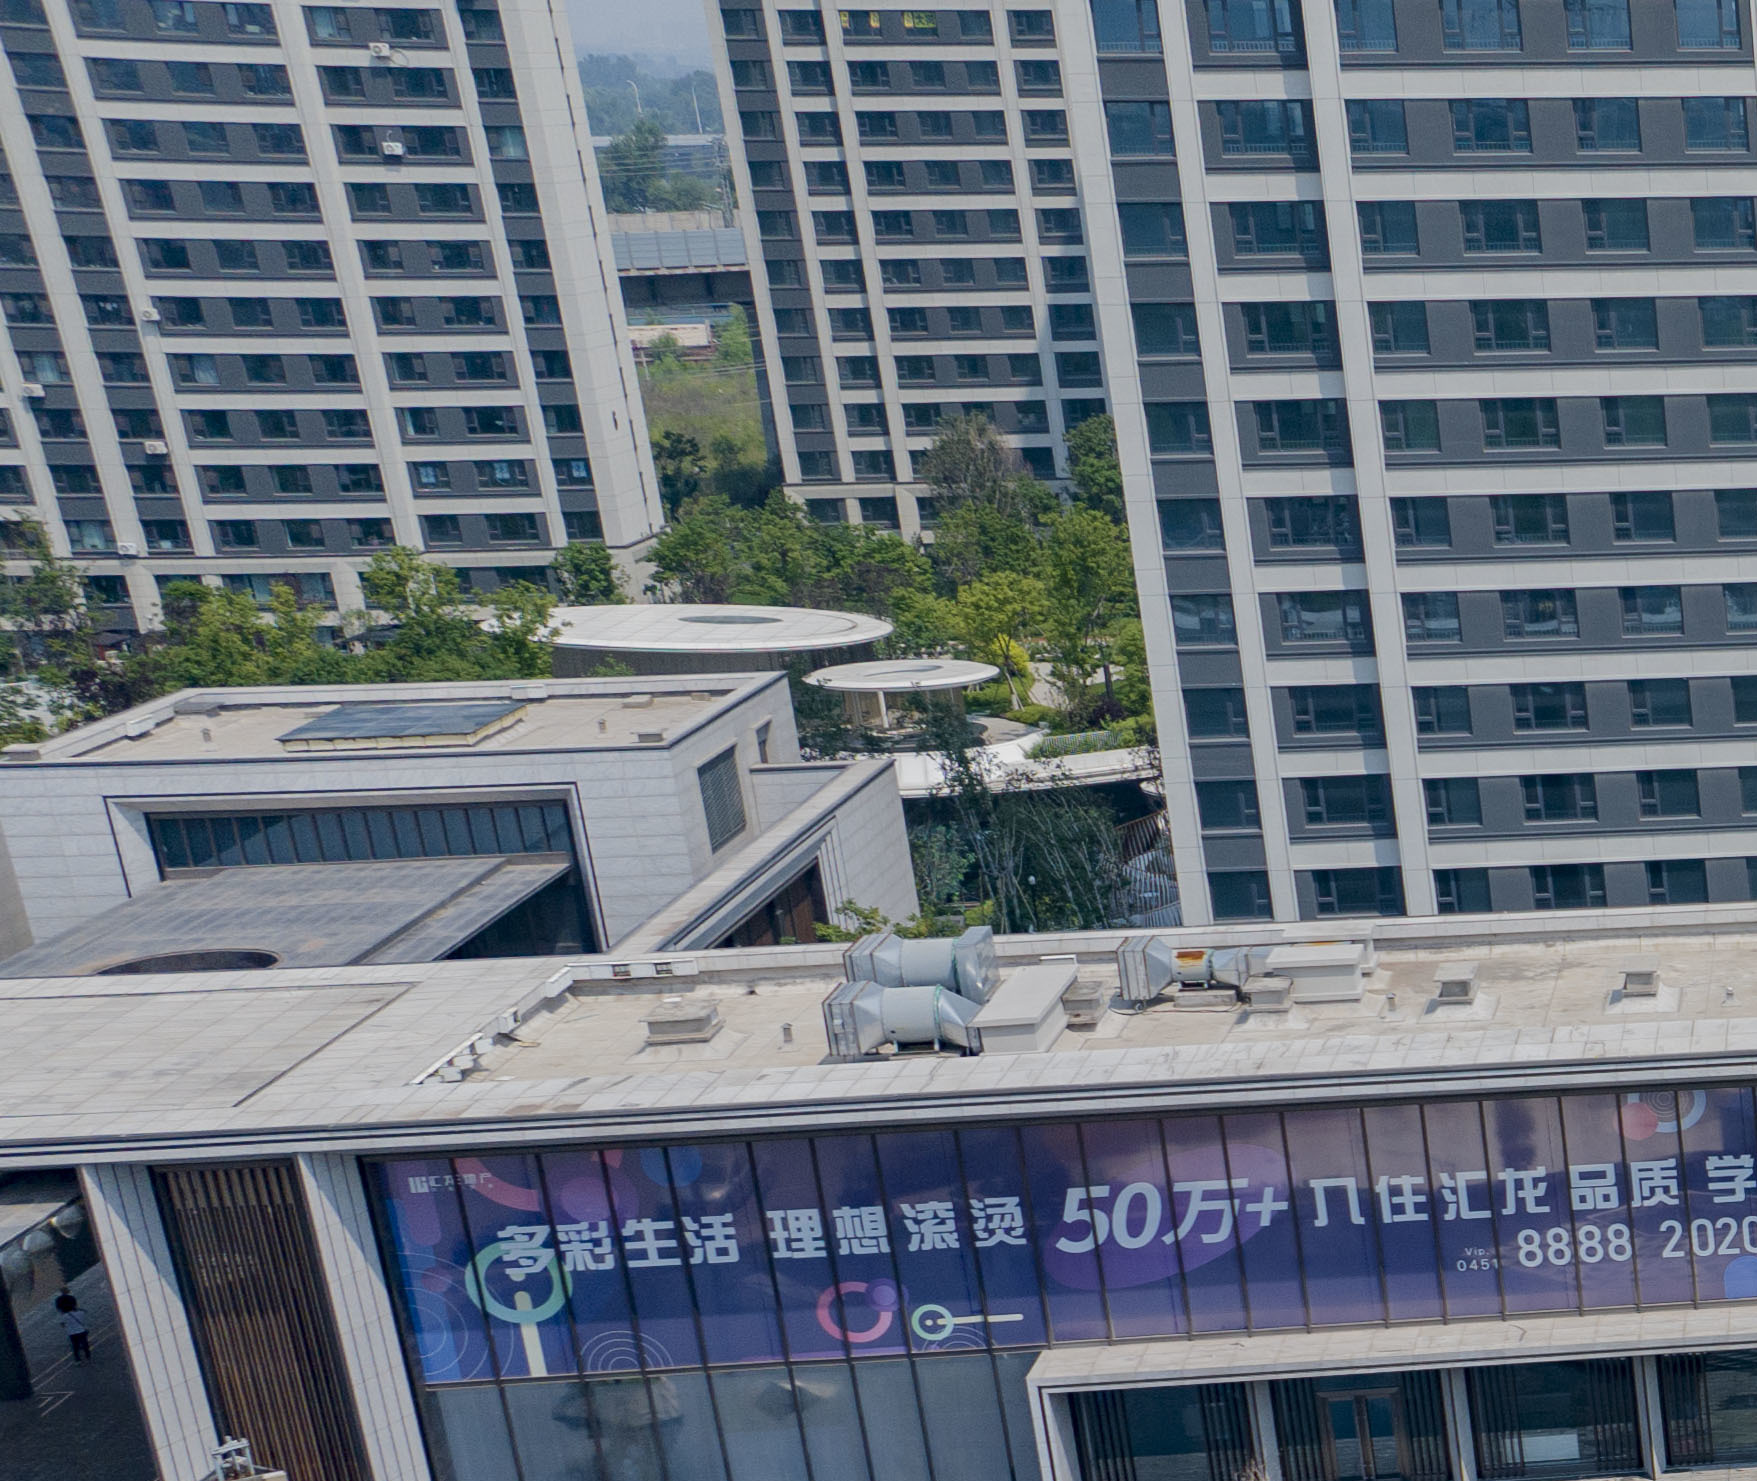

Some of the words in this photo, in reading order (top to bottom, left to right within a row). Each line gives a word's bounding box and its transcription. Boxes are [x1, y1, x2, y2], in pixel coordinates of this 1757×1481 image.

[497, 1213, 740, 1276] 多彩生活
[767, 1197, 1028, 1259] 理想滚烫
[1456, 1258, 1499, 1272] 0451
[1517, 1222, 1633, 1269] 8888
